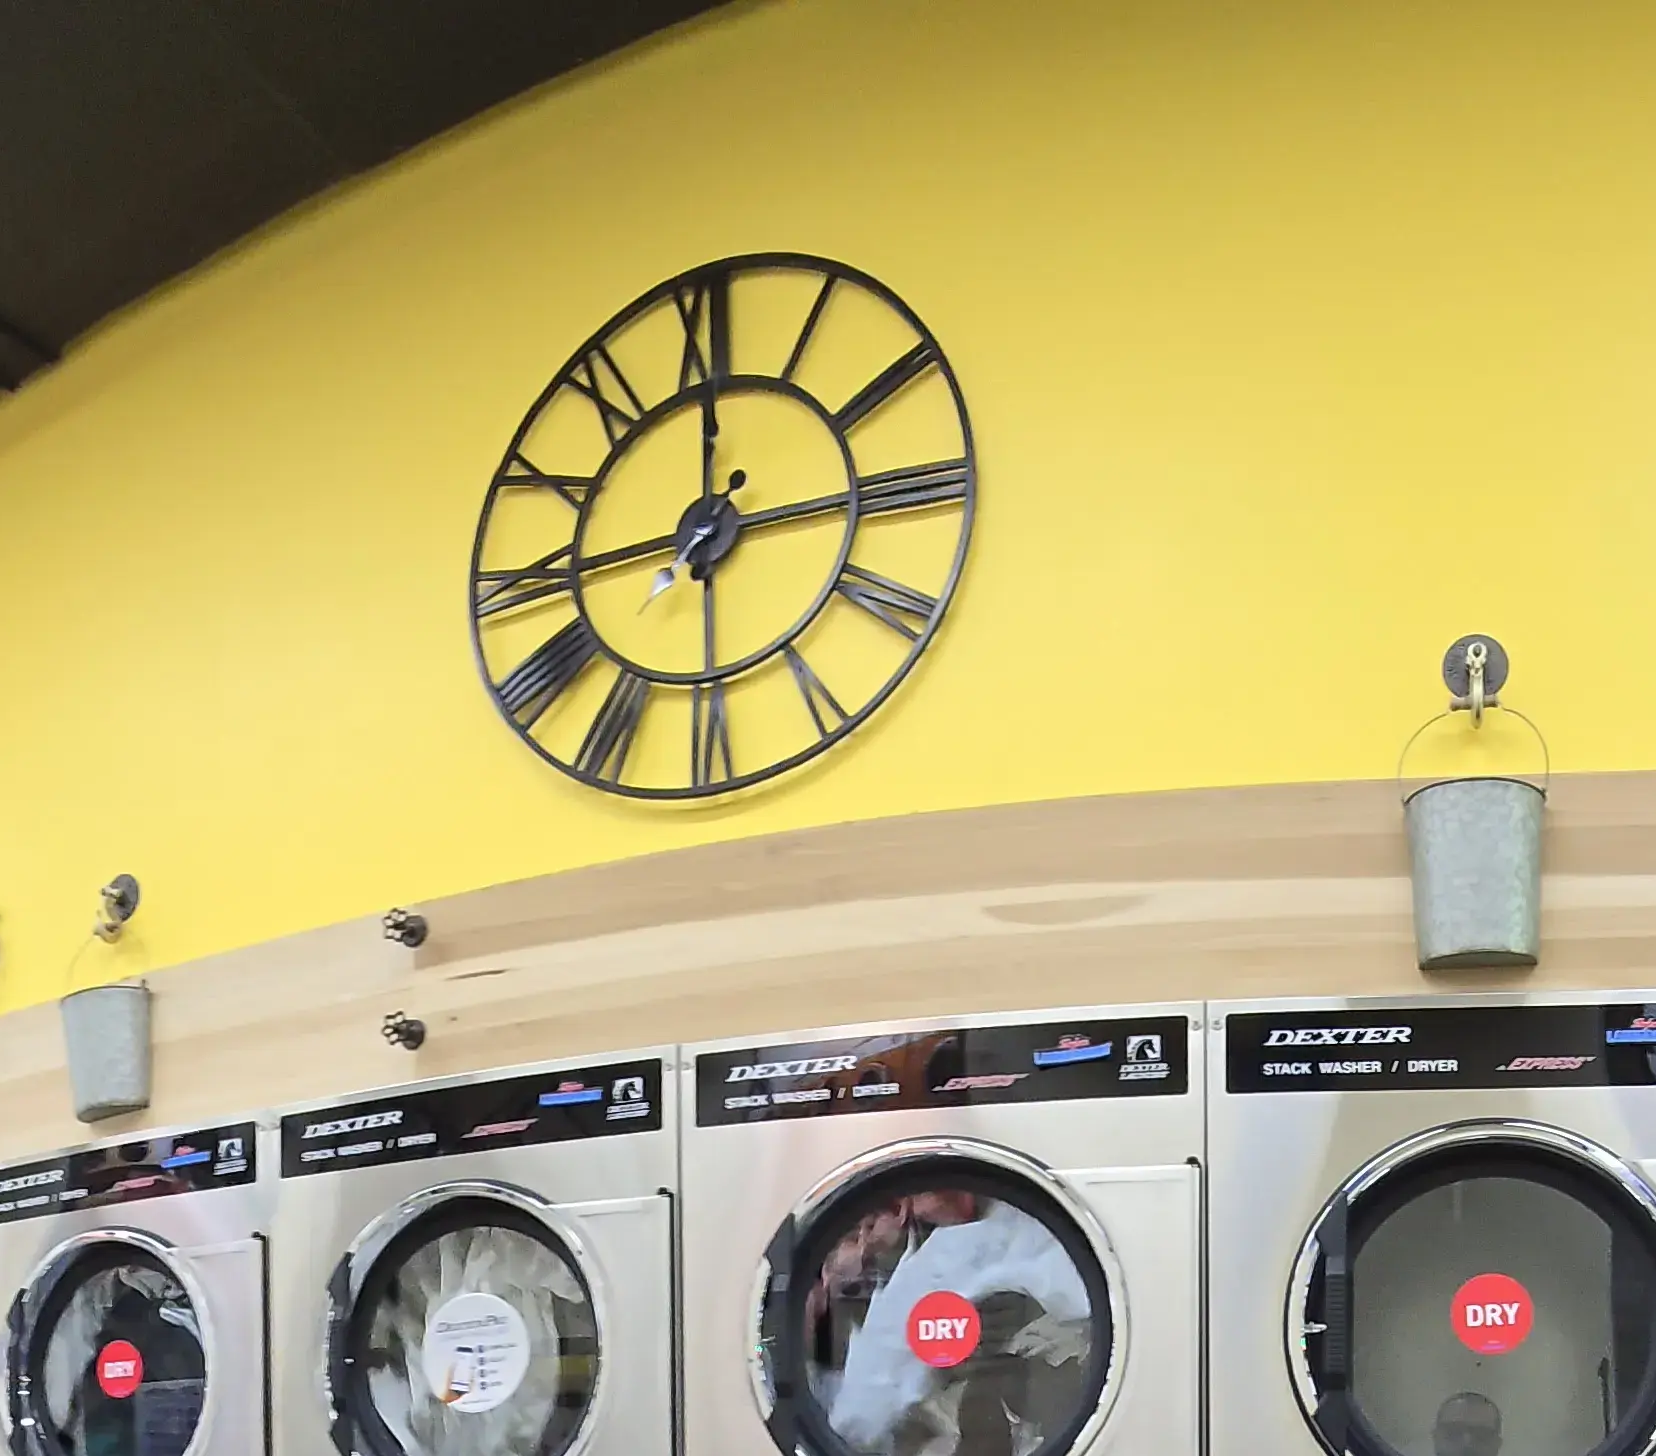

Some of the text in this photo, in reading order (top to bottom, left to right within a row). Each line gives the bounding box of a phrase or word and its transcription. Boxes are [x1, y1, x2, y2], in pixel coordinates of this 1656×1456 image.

[1263, 1026, 1412, 1046] DEXTER
[725, 1055, 857, 1082] DEXTER
[1263, 1061, 1312, 1076] STACK
[1320, 1060, 1381, 1075] WASHER
[1407, 1059, 1458, 1074] DRYER
[301, 1110, 404, 1139] DEXTER
[1465, 1302, 1520, 1327] DRY
[918, 1318, 969, 1341] DRY
